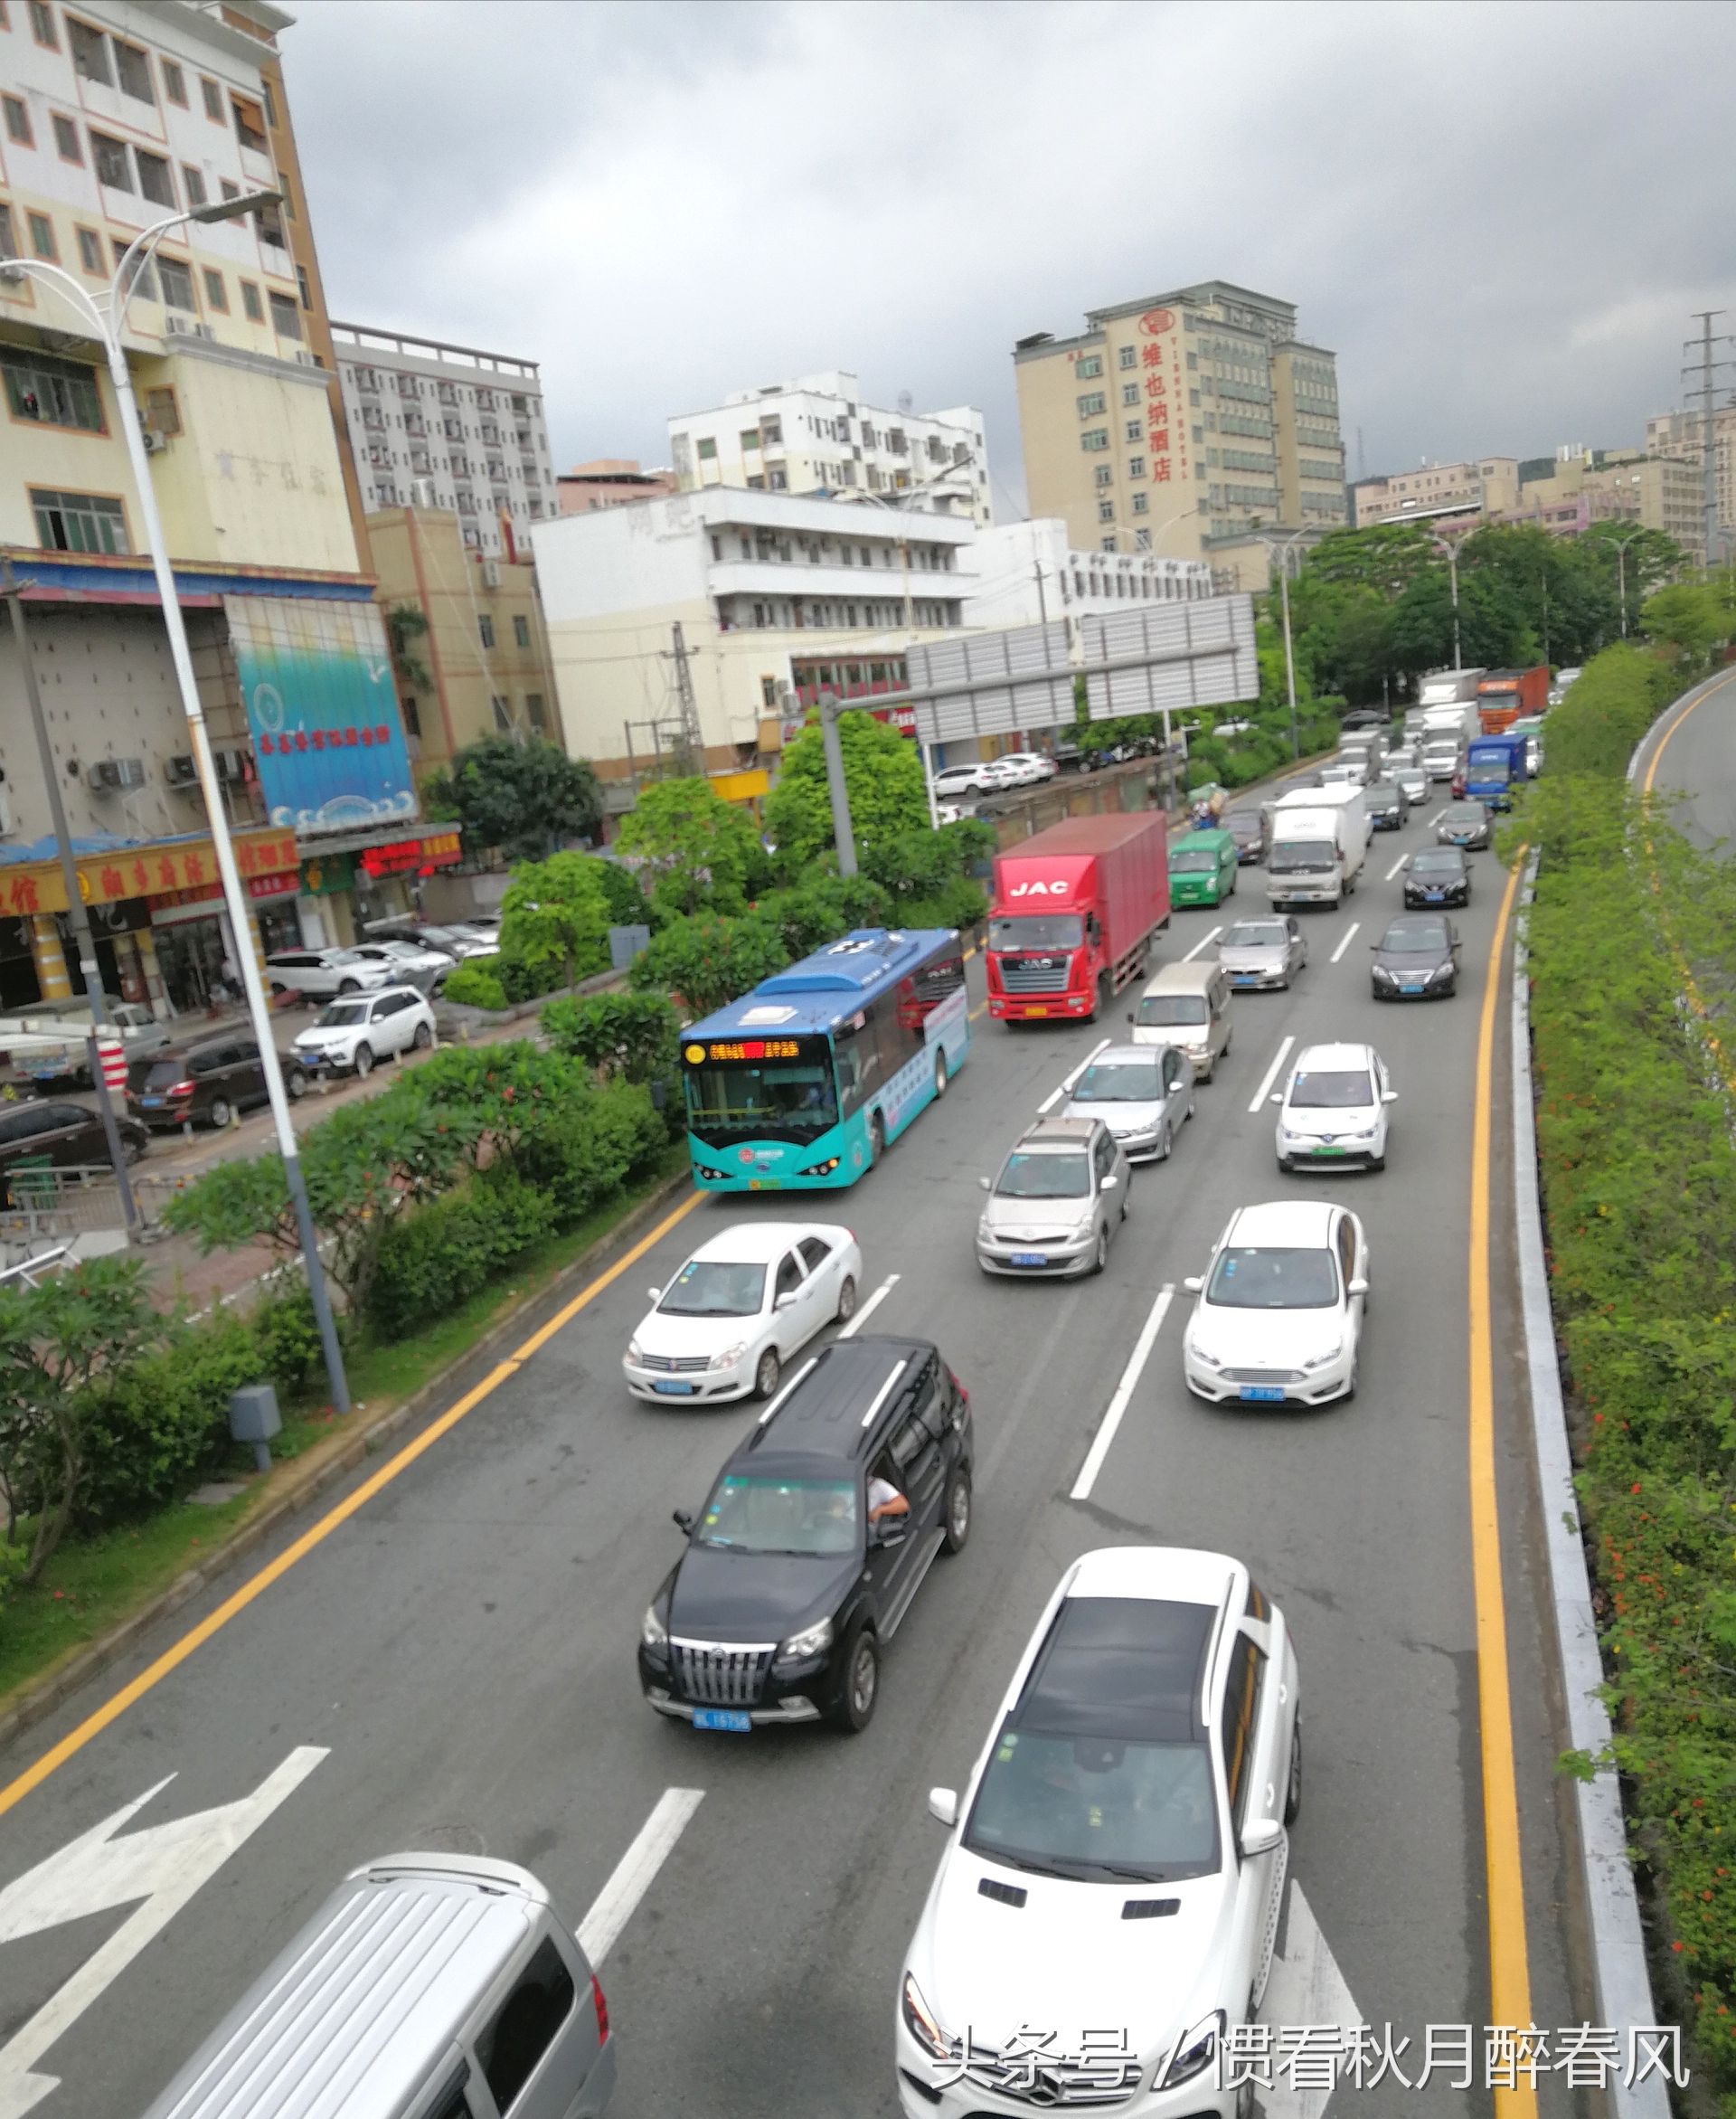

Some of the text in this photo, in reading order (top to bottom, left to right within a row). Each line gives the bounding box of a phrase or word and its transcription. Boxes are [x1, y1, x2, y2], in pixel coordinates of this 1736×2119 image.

[1141, 342, 1173, 484] 维也纳酒店
[1010, 880, 1069, 897] JAC
[1018, 958, 1053, 970] JAC
